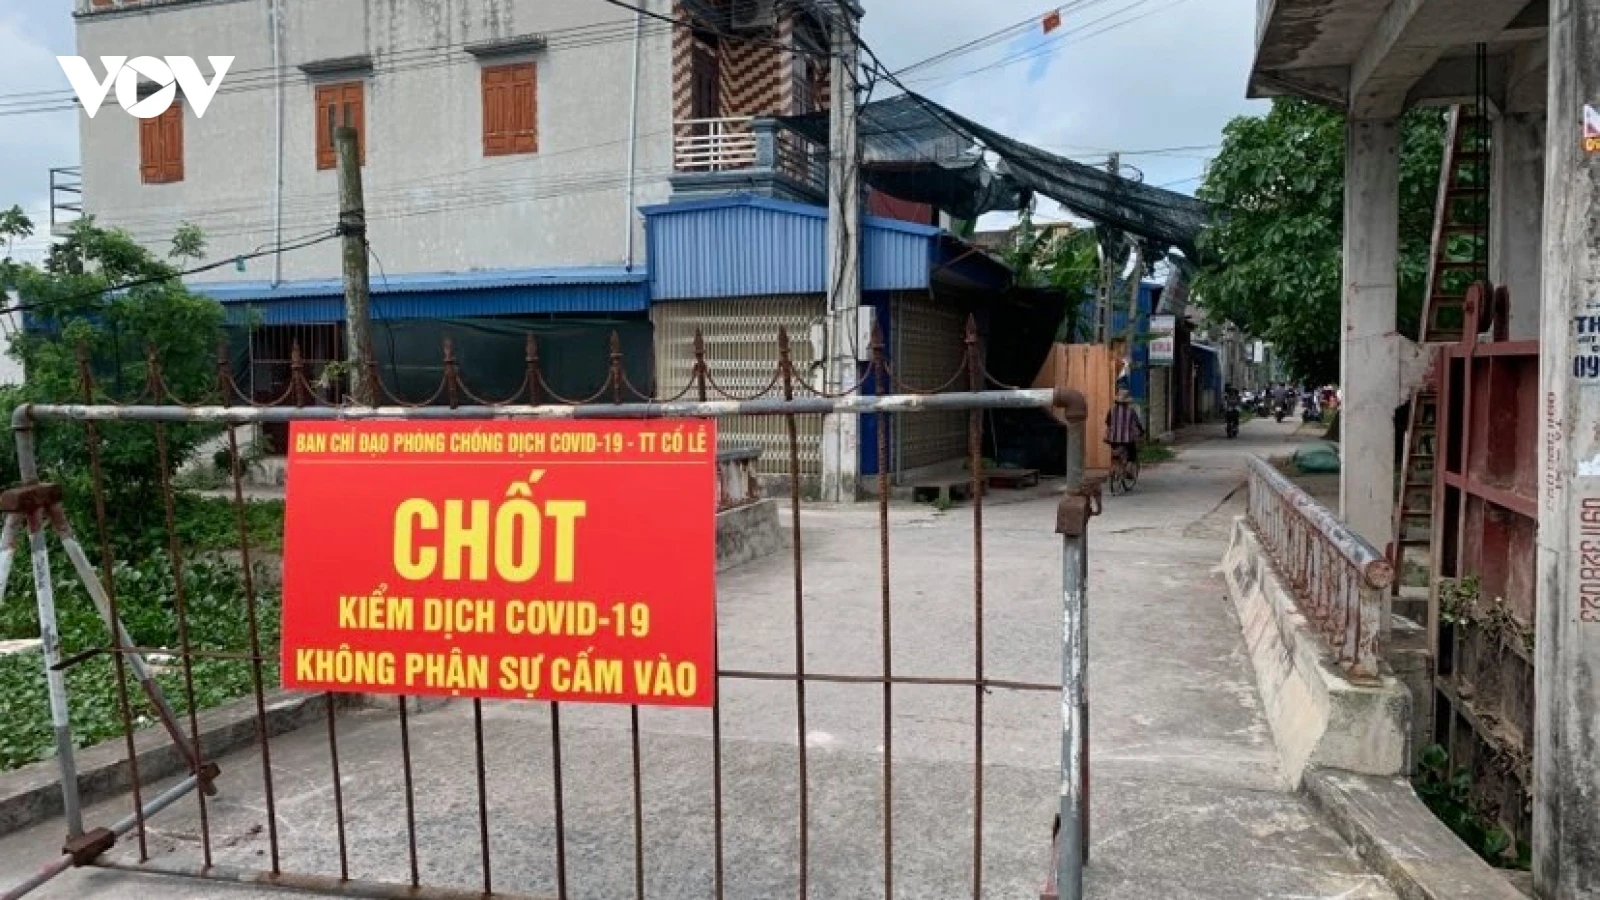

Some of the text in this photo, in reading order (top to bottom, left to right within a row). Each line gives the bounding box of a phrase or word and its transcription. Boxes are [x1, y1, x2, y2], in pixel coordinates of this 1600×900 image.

[295, 432, 326, 453] BAN
[359, 432, 389, 458] ĐẠO
[393, 428, 446, 453] PHÒNG
[450, 425, 505, 453] CHỐNG
[507, 432, 546, 458] DỊCH
[549, 432, 624, 453] COVID-19
[638, 432, 657, 453] TT
[394, 469, 587, 582] CHỐT
[339, 583, 650, 640] KIỂM DỊCH COVID-19
[296, 643, 698, 698] KHÔNG PHẬN SỰ CẤM VÀO
